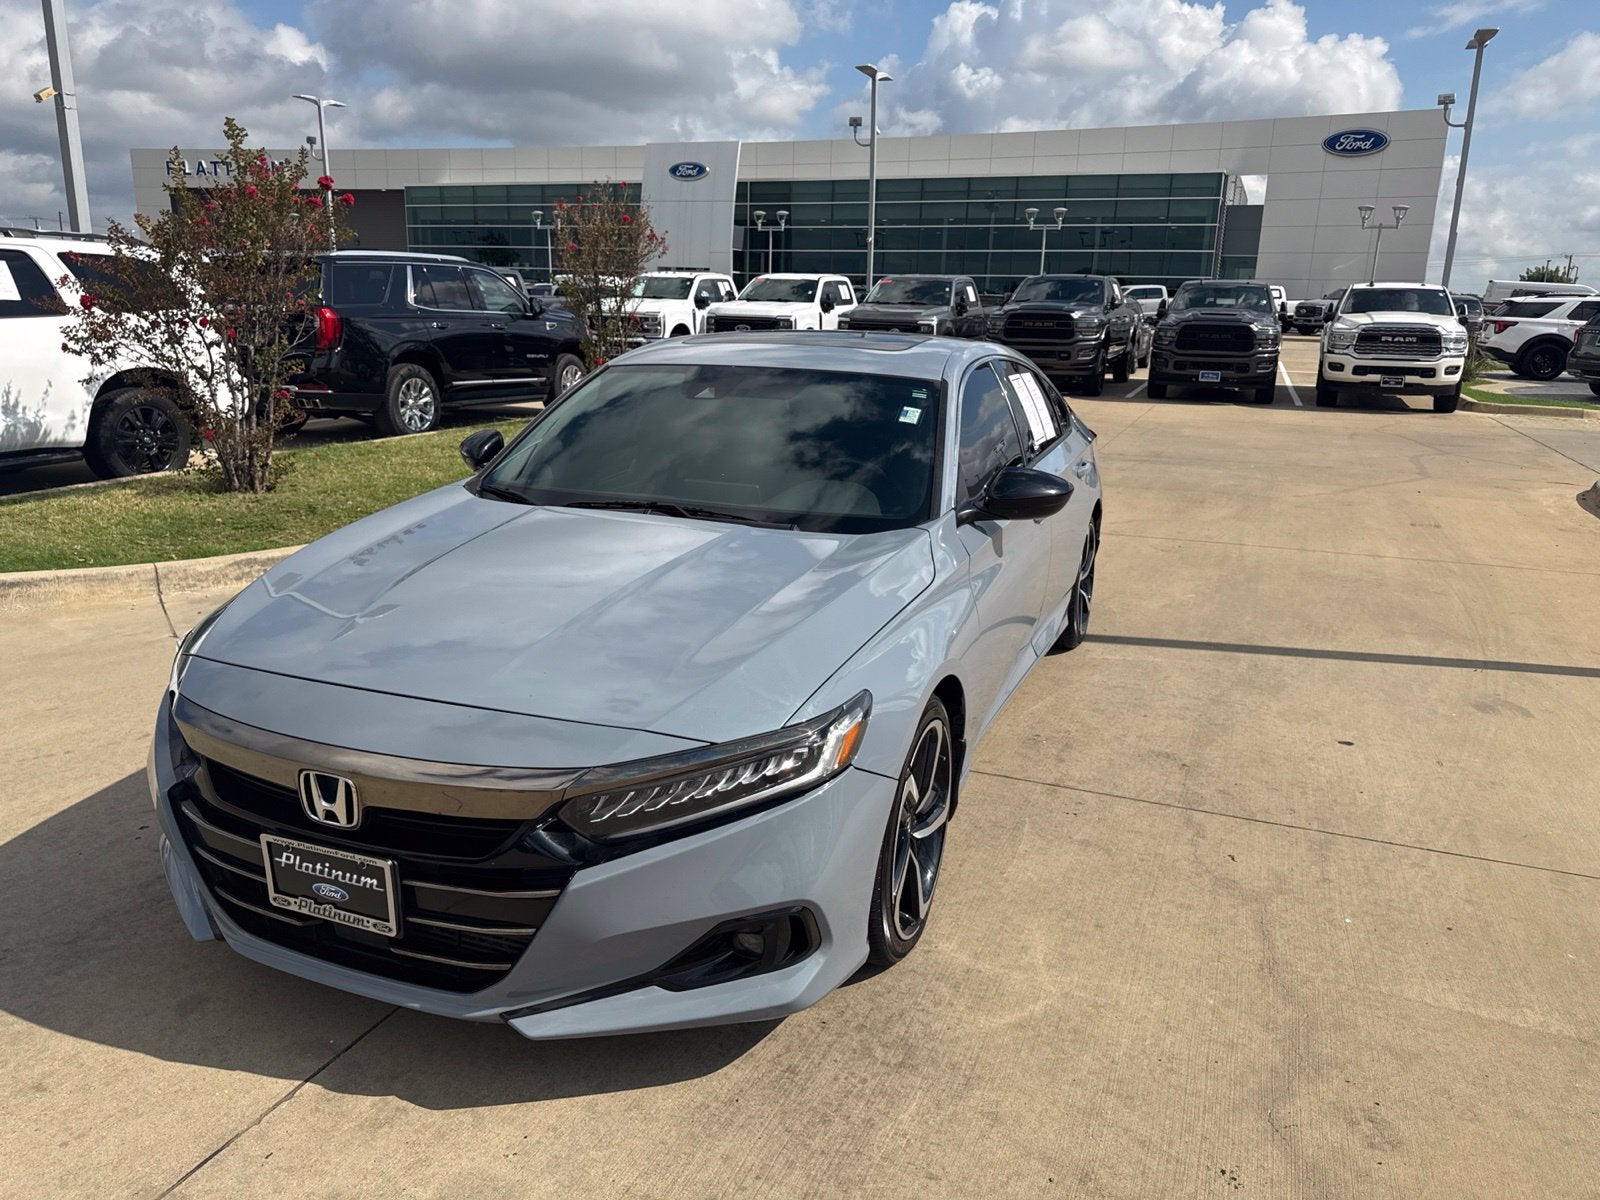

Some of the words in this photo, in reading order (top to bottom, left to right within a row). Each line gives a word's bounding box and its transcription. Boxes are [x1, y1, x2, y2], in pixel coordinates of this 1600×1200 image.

[1335, 134, 1375, 150] Ford
[163, 160, 286, 176] PLATI
[675, 164, 699, 176] Ford
[1381, 335, 1417, 343] RAM
[274, 851, 385, 892] Platinum
[319, 884, 342, 899] Ford
[297, 897, 370, 928] Platinum
